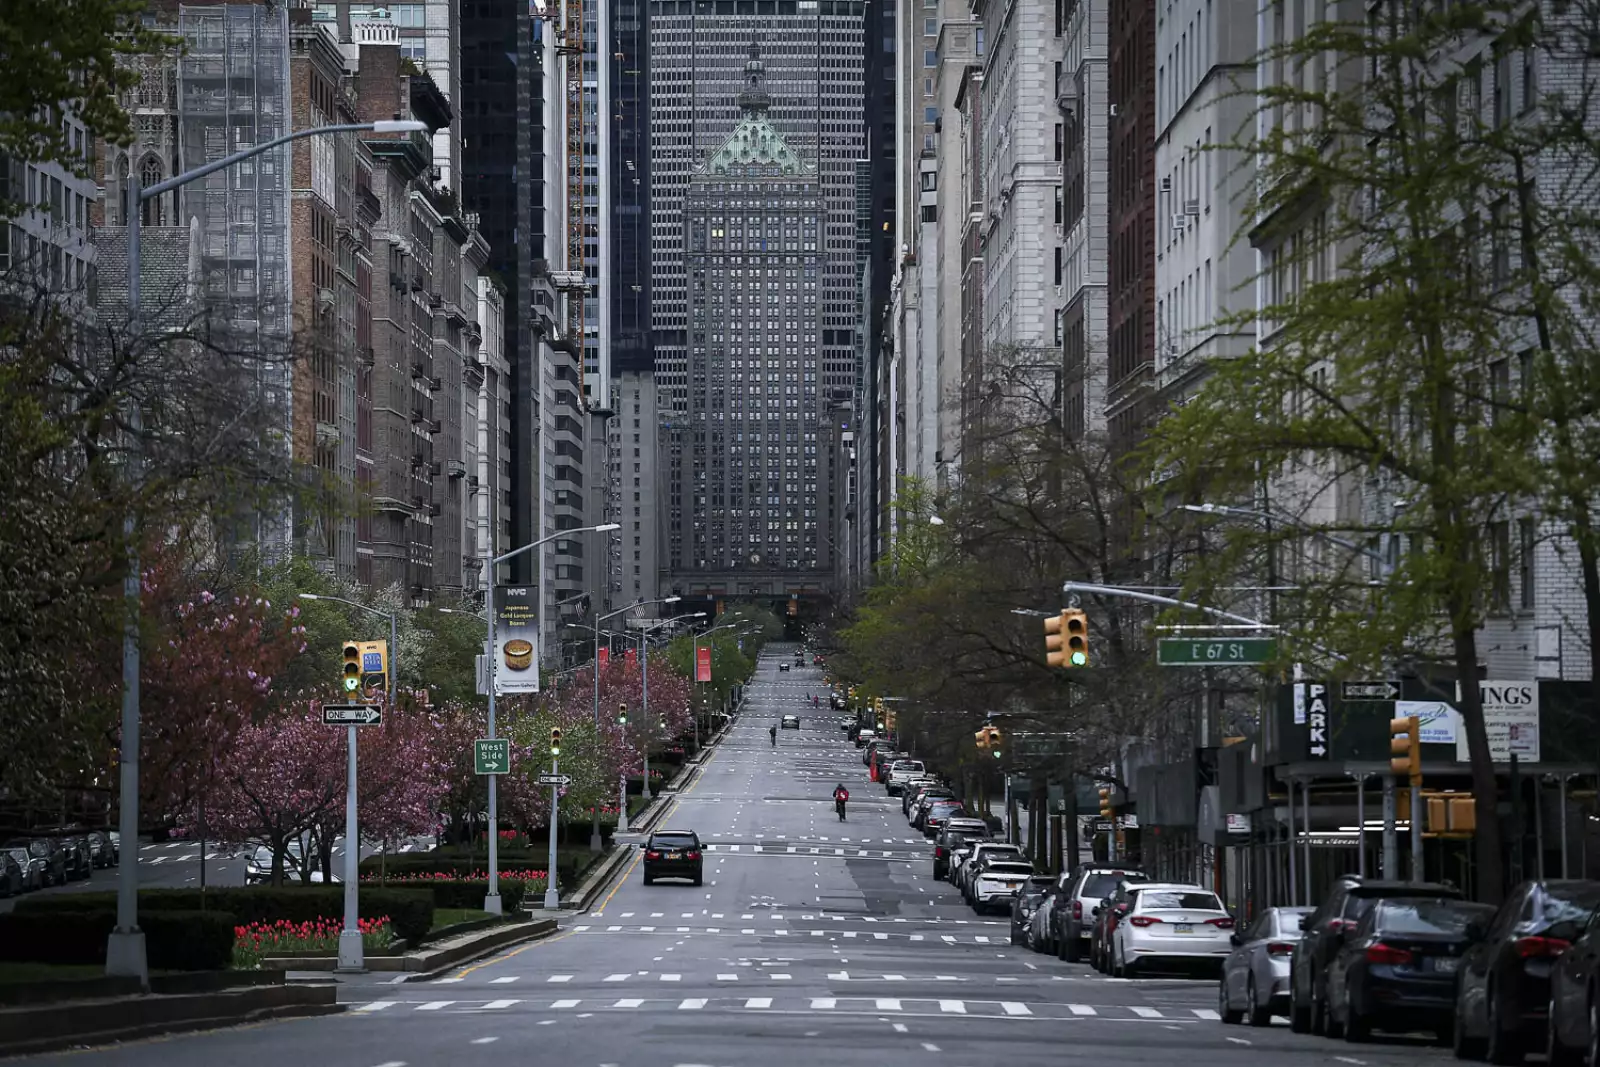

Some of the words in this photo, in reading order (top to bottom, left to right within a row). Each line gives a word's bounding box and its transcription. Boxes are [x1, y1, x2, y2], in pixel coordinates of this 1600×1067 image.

[507, 588, 527, 596] NYC
[1192, 643, 1201, 659] E
[1206, 643, 1224, 659] 67
[1229, 643, 1245, 659] St
[1479, 686, 1532, 705] INGS
[328, 711, 346, 719] ONE
[355, 711, 373, 719] WAY
[1310, 684, 1327, 742] PARK
